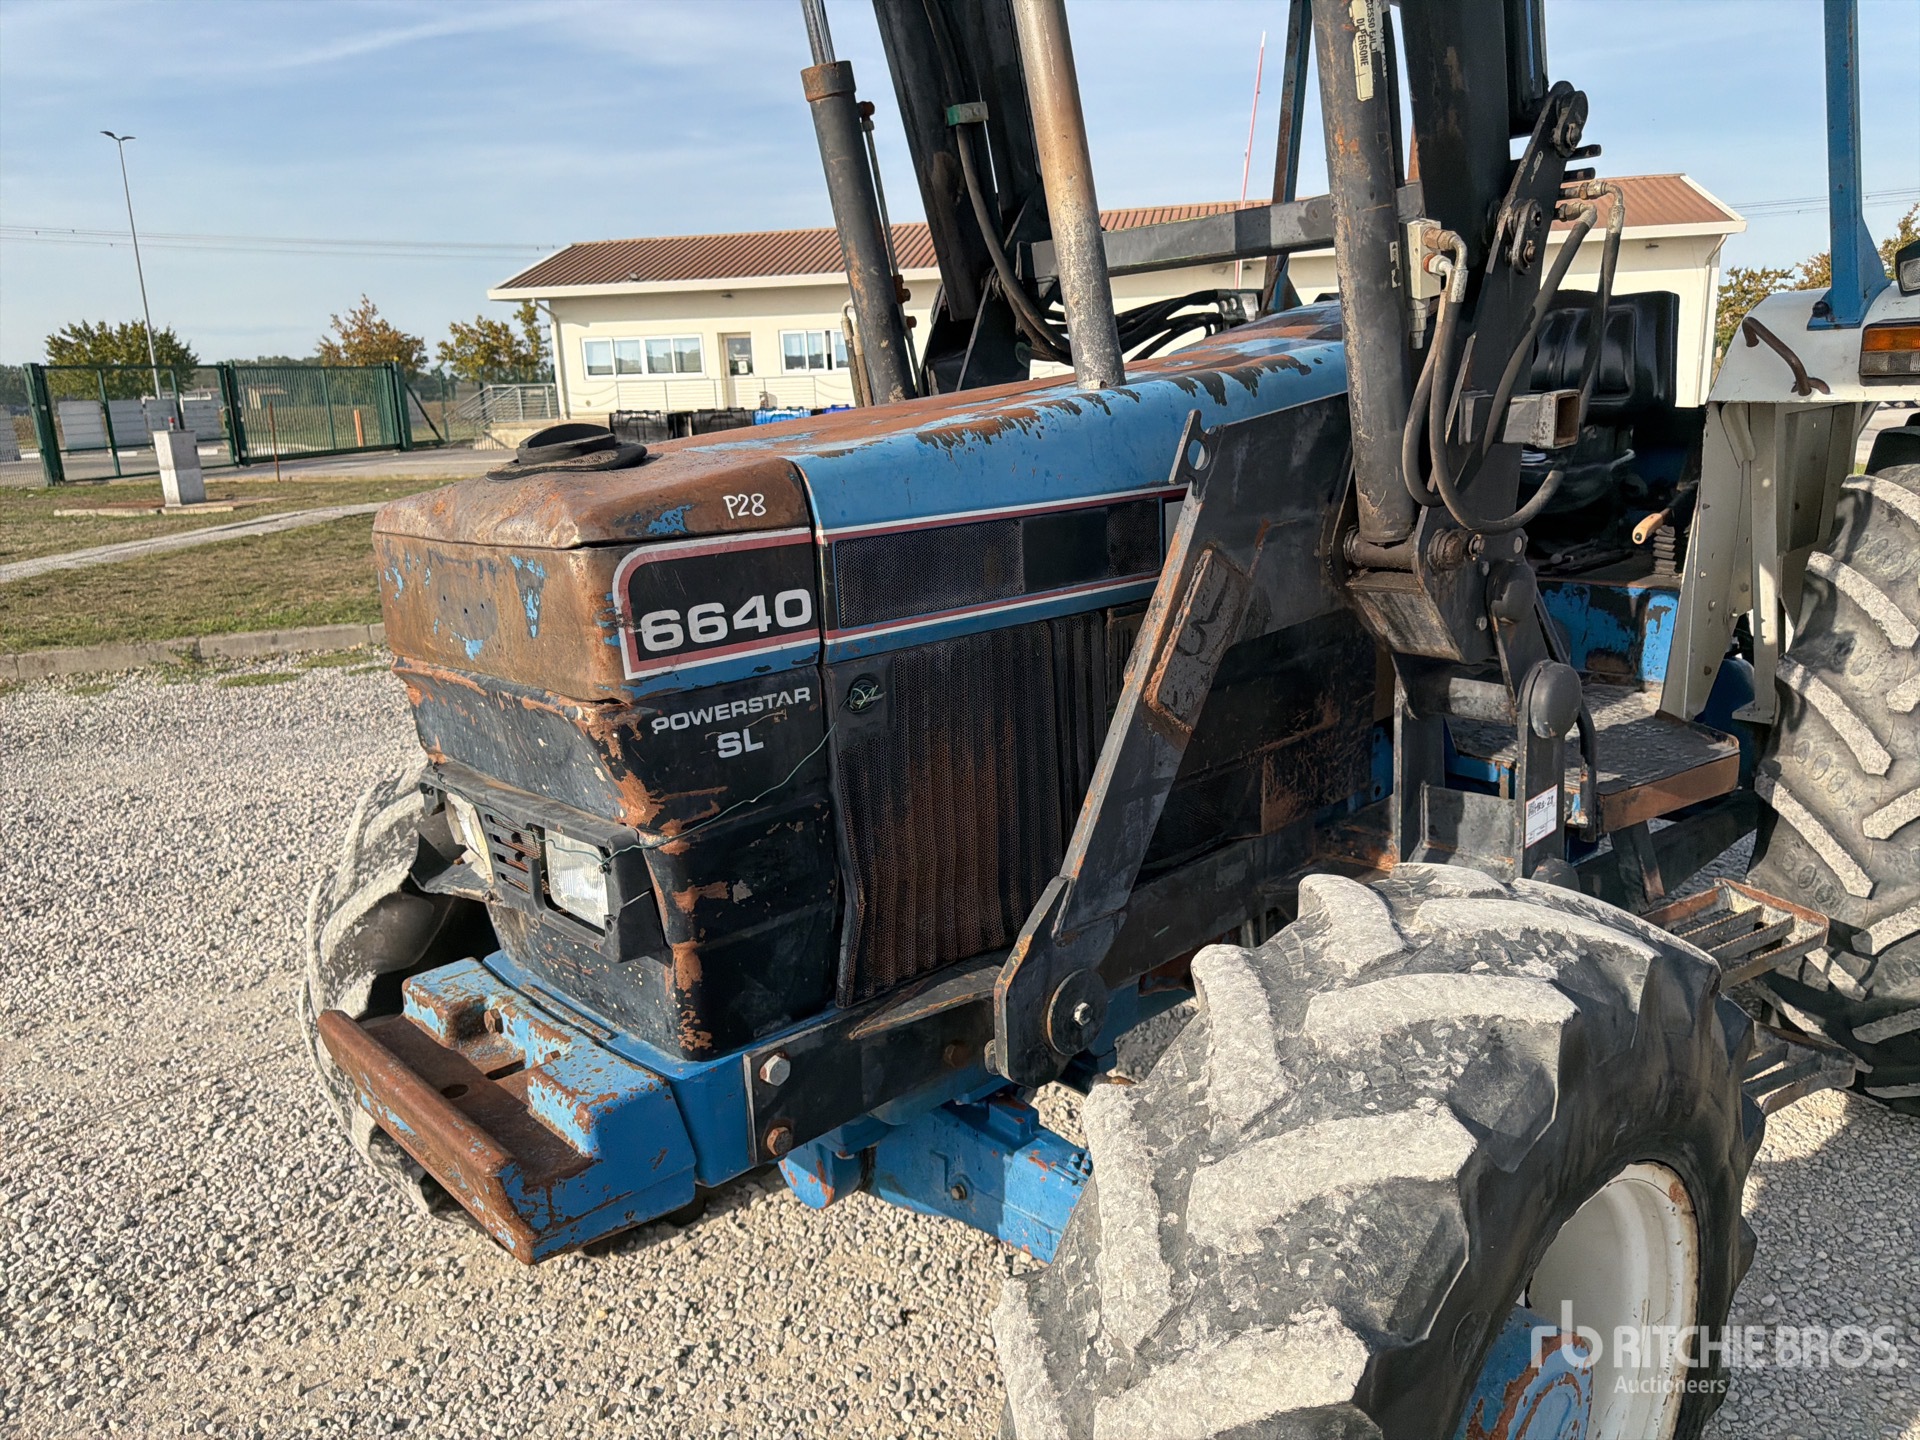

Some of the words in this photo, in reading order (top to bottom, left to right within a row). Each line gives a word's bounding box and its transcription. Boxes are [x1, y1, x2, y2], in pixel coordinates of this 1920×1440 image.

[1358, 29, 1369, 67] PERSONE
[723, 493, 767, 519] P28
[640, 588, 812, 652] 6640
[651, 686, 811, 734] POWERSTAR
[717, 728, 764, 759] SL
